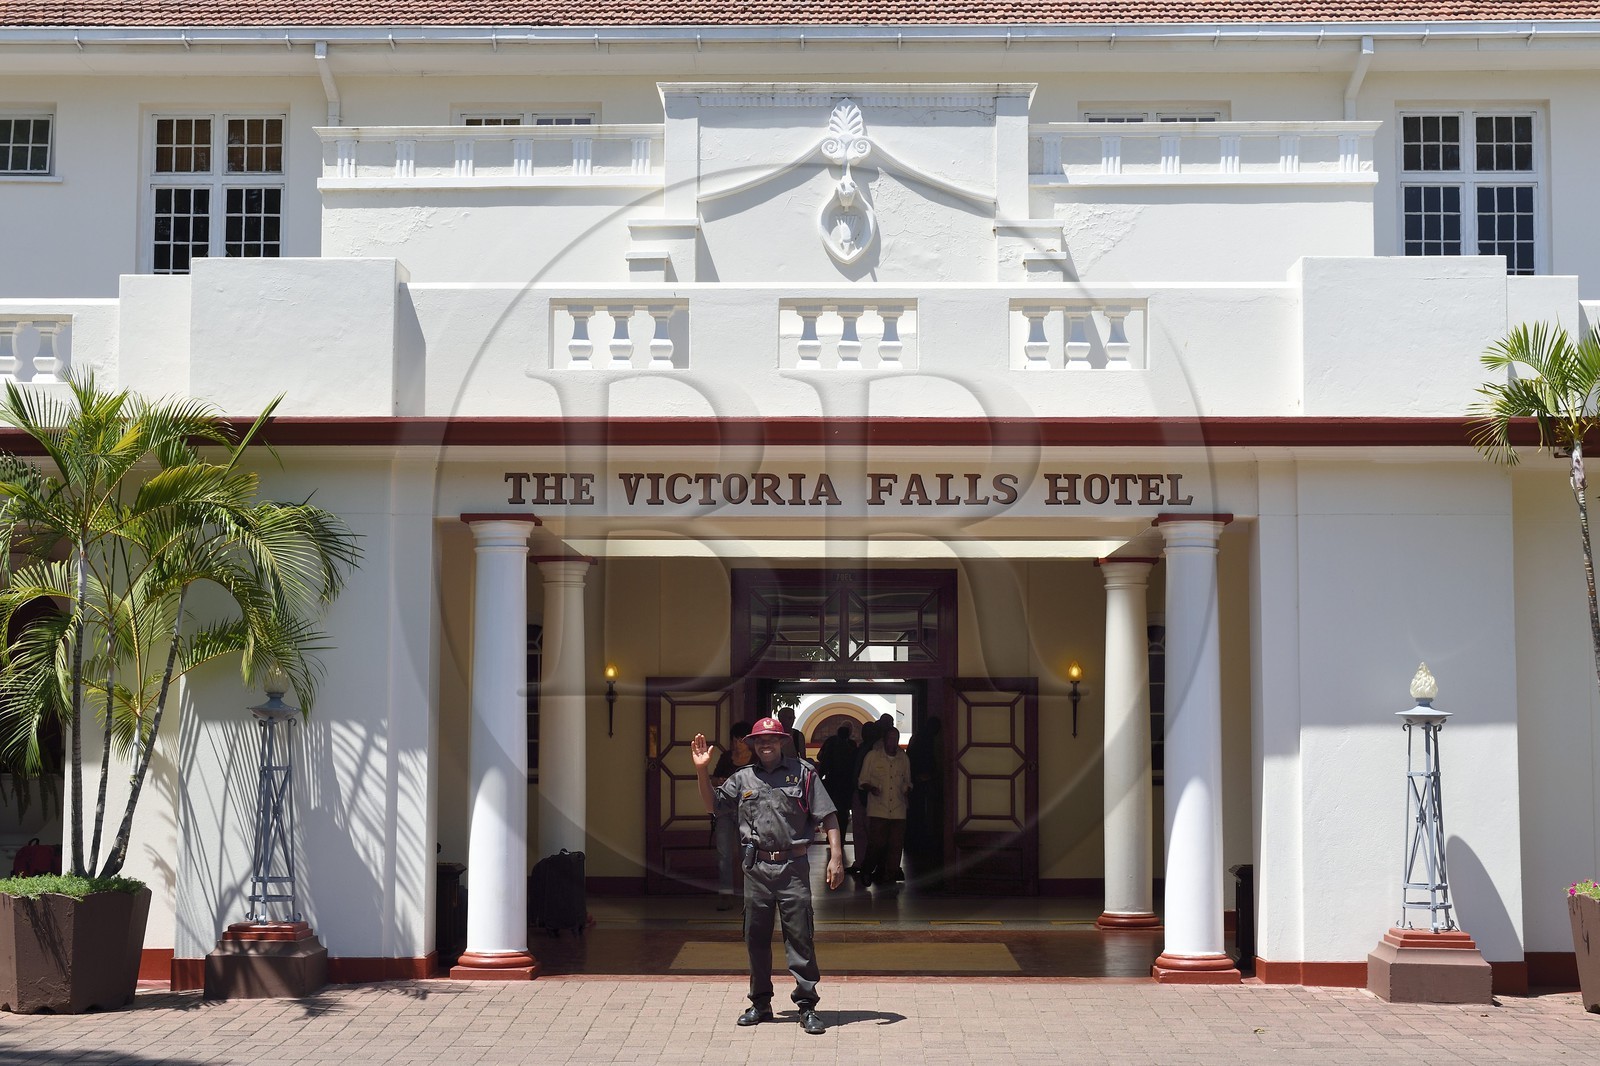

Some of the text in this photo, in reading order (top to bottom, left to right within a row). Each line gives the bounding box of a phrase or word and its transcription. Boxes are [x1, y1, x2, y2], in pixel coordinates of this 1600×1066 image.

[503, 472, 1194, 506] THE VICTORIA FALLS HOTEL
